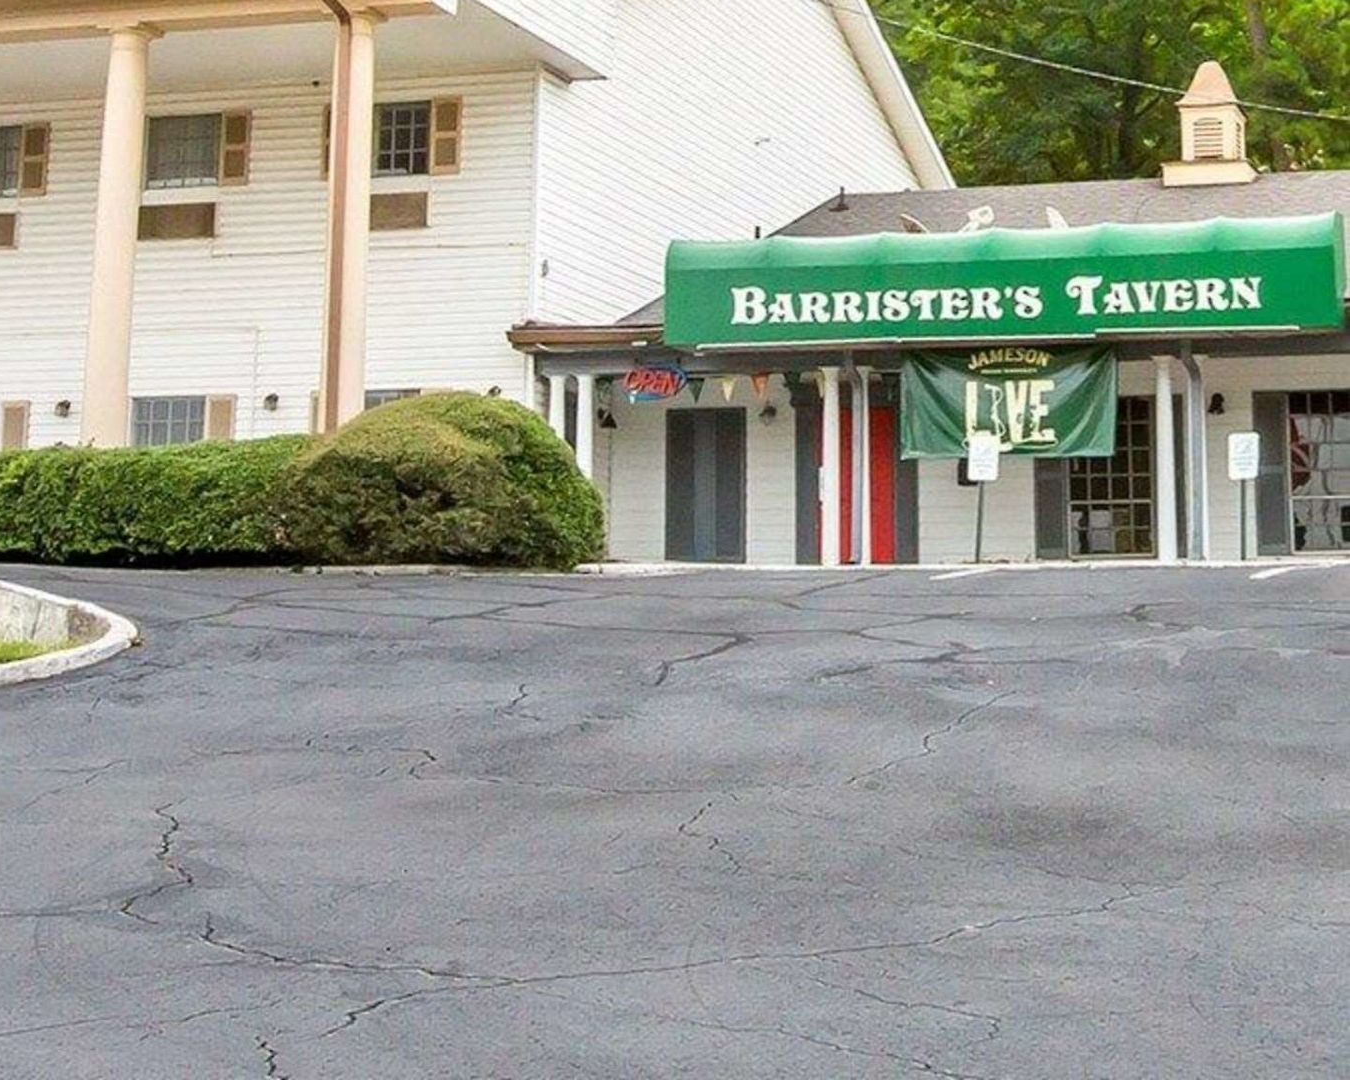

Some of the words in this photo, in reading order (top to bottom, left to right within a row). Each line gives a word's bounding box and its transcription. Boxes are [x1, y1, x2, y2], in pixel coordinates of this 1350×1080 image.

[730, 285, 1044, 325] BARRISTER'S
[1065, 274, 1263, 315] TAVERN
[967, 347, 1051, 370] JAMESON
[623, 367, 679, 396] OPEN
[965, 379, 1056, 444] LIVE
